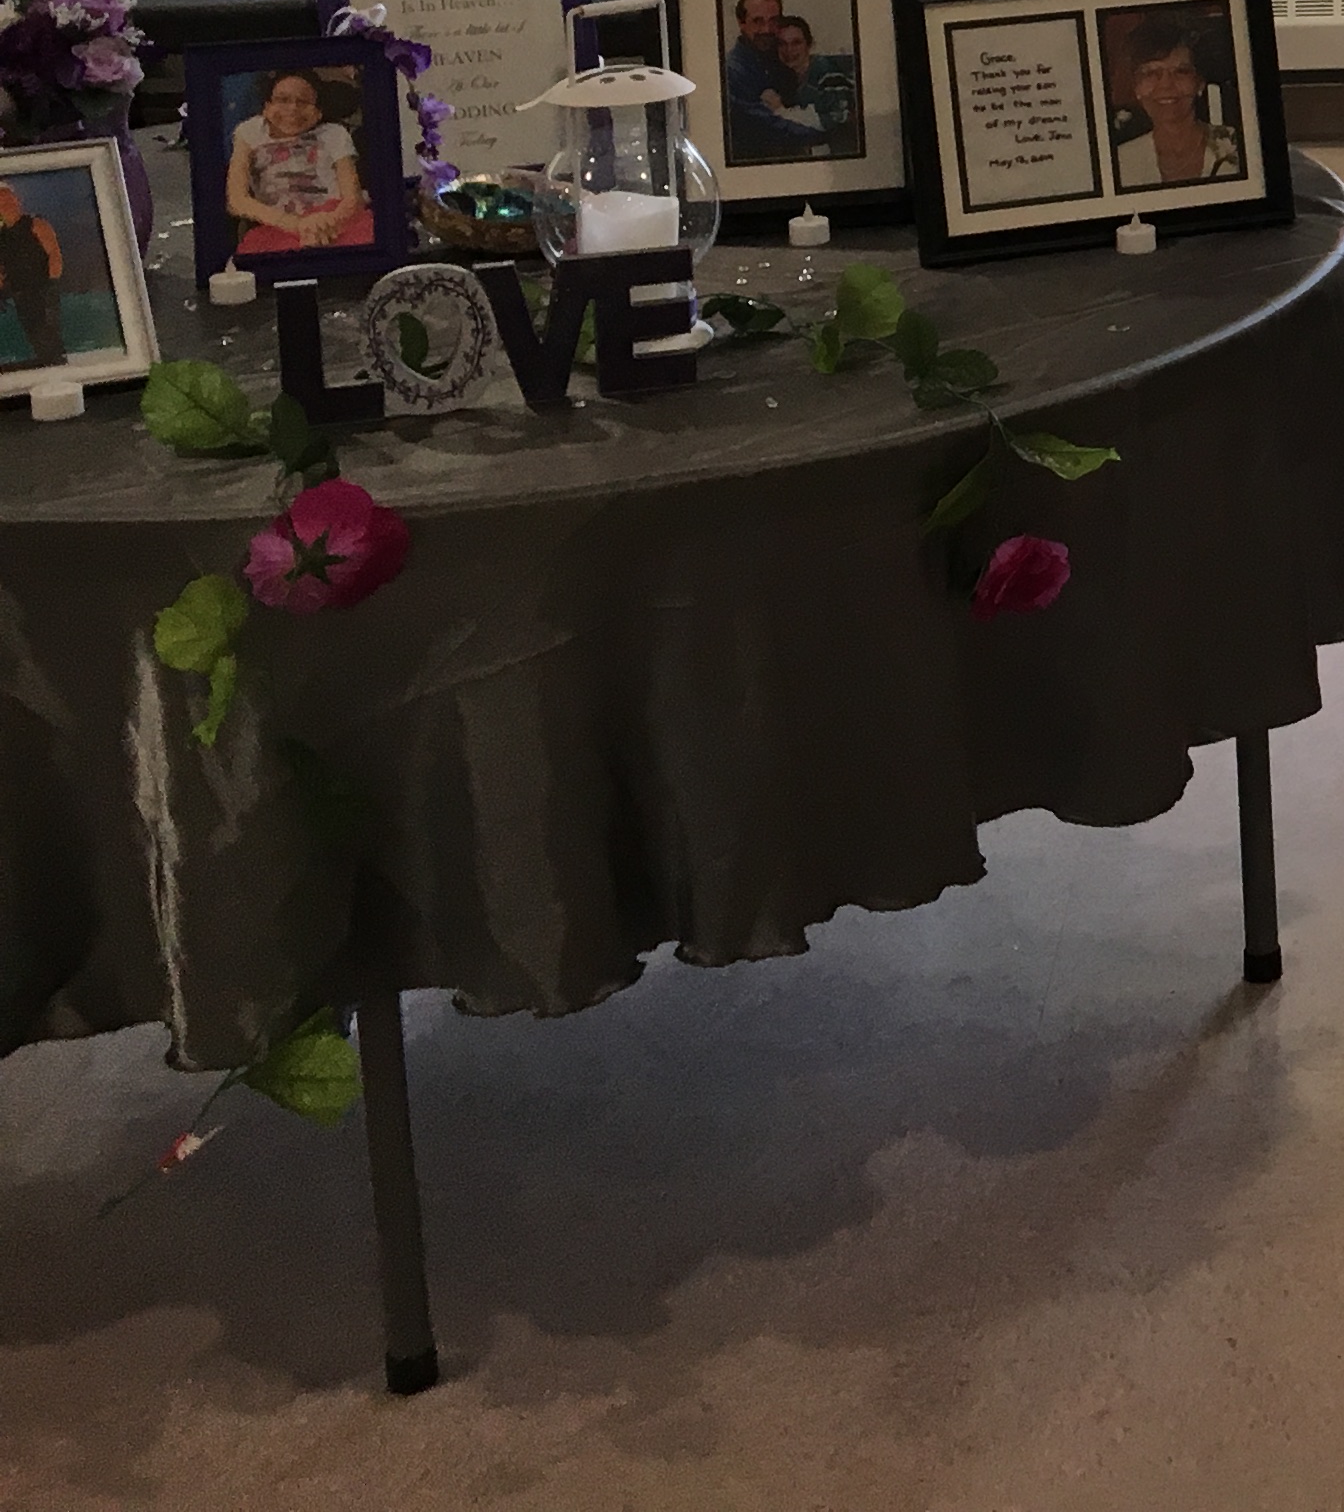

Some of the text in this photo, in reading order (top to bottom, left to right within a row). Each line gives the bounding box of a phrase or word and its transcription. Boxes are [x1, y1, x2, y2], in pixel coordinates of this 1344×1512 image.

[401, 0, 415, 14] Is
[420, 0, 436, 13] In
[433, 49, 503, 67] EAVEN
[970, 63, 1053, 82] Thank you for
[971, 81, 1057, 98] raising your son
[1013, 99, 1032, 109] the
[1040, 98, 1062, 107] man
[1003, 118, 1022, 130] my
[1028, 114, 1068, 126] dreams
[988, 158, 1013, 170] May
[274, 245, 699, 428] LOVE
